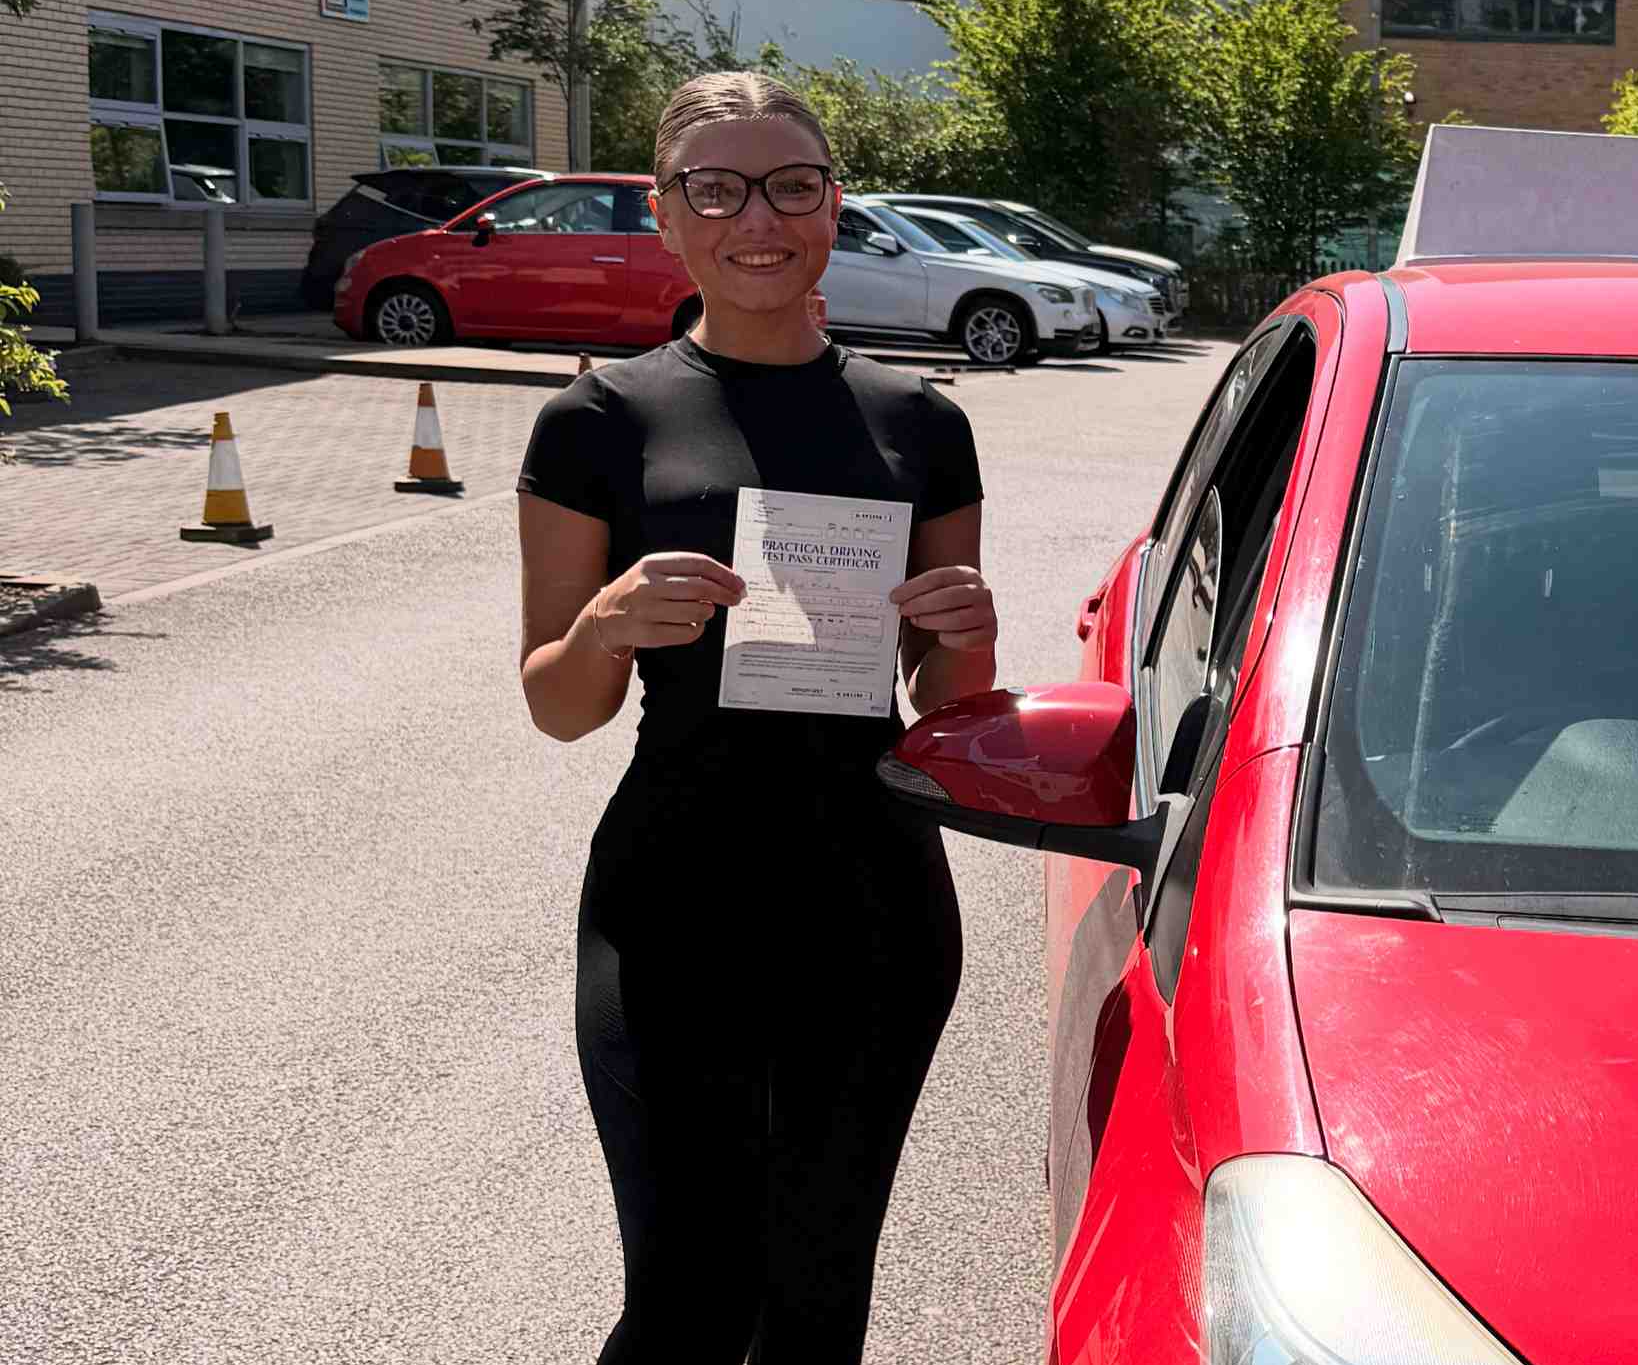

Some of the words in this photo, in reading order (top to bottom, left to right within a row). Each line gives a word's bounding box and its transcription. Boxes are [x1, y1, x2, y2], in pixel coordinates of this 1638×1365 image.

[762, 539, 825, 555] PRACTICAL
[830, 545, 881, 560] DRIVING
[761, 551, 784, 562] TEST
[788, 554, 813, 564] PASS
[816, 555, 881, 570] CERTIFICATE
